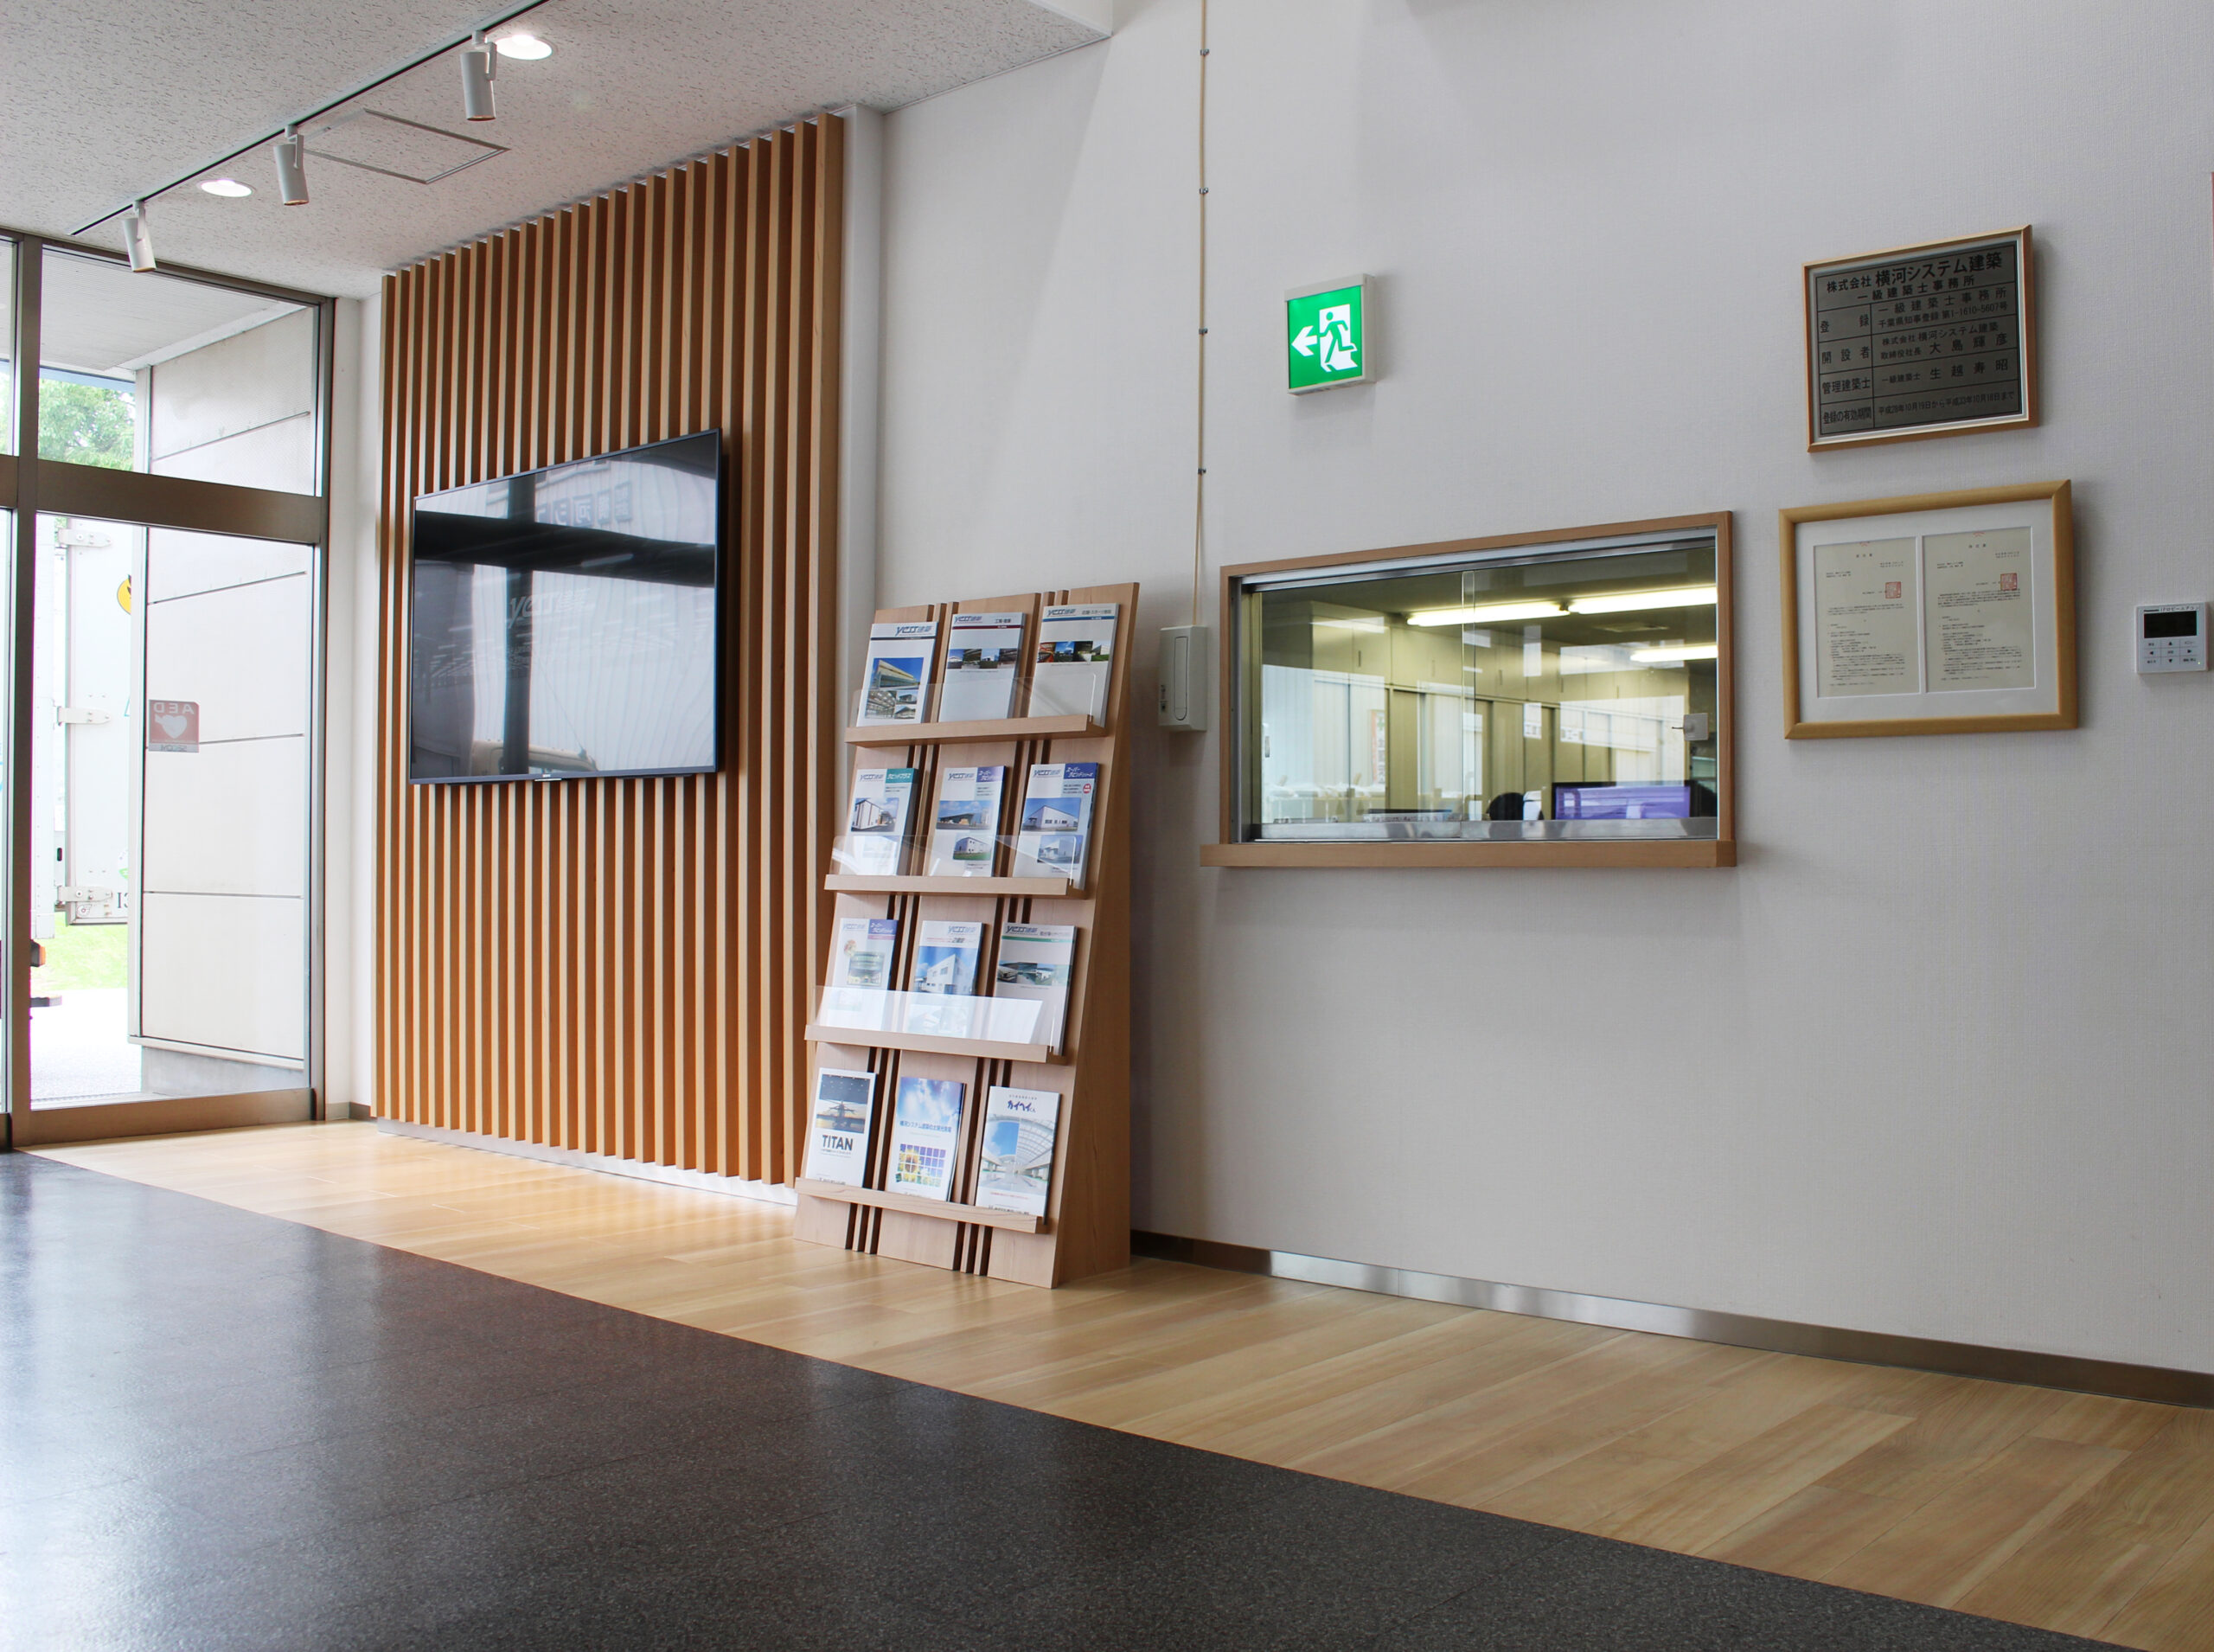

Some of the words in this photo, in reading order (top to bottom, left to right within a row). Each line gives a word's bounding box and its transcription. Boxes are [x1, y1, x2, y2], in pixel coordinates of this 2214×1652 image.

[1827, 275, 1872, 293] 株式会社
[1875, 251, 2003, 285] 横河システム建築
[1856, 275, 1975, 301] 一級建築士事務所
[1878, 286, 2007, 313] 一級建築士事務所
[1878, 311, 1941, 329] 千葉県知事登録
[1882, 333, 1915, 346] 株式会社
[1917, 322, 1999, 342] 横河システム建築
[1822, 377, 1871, 395] 管理建築士
[1882, 372, 1921, 384] 一級建築士
[822, 1134, 854, 1151] TITAN
